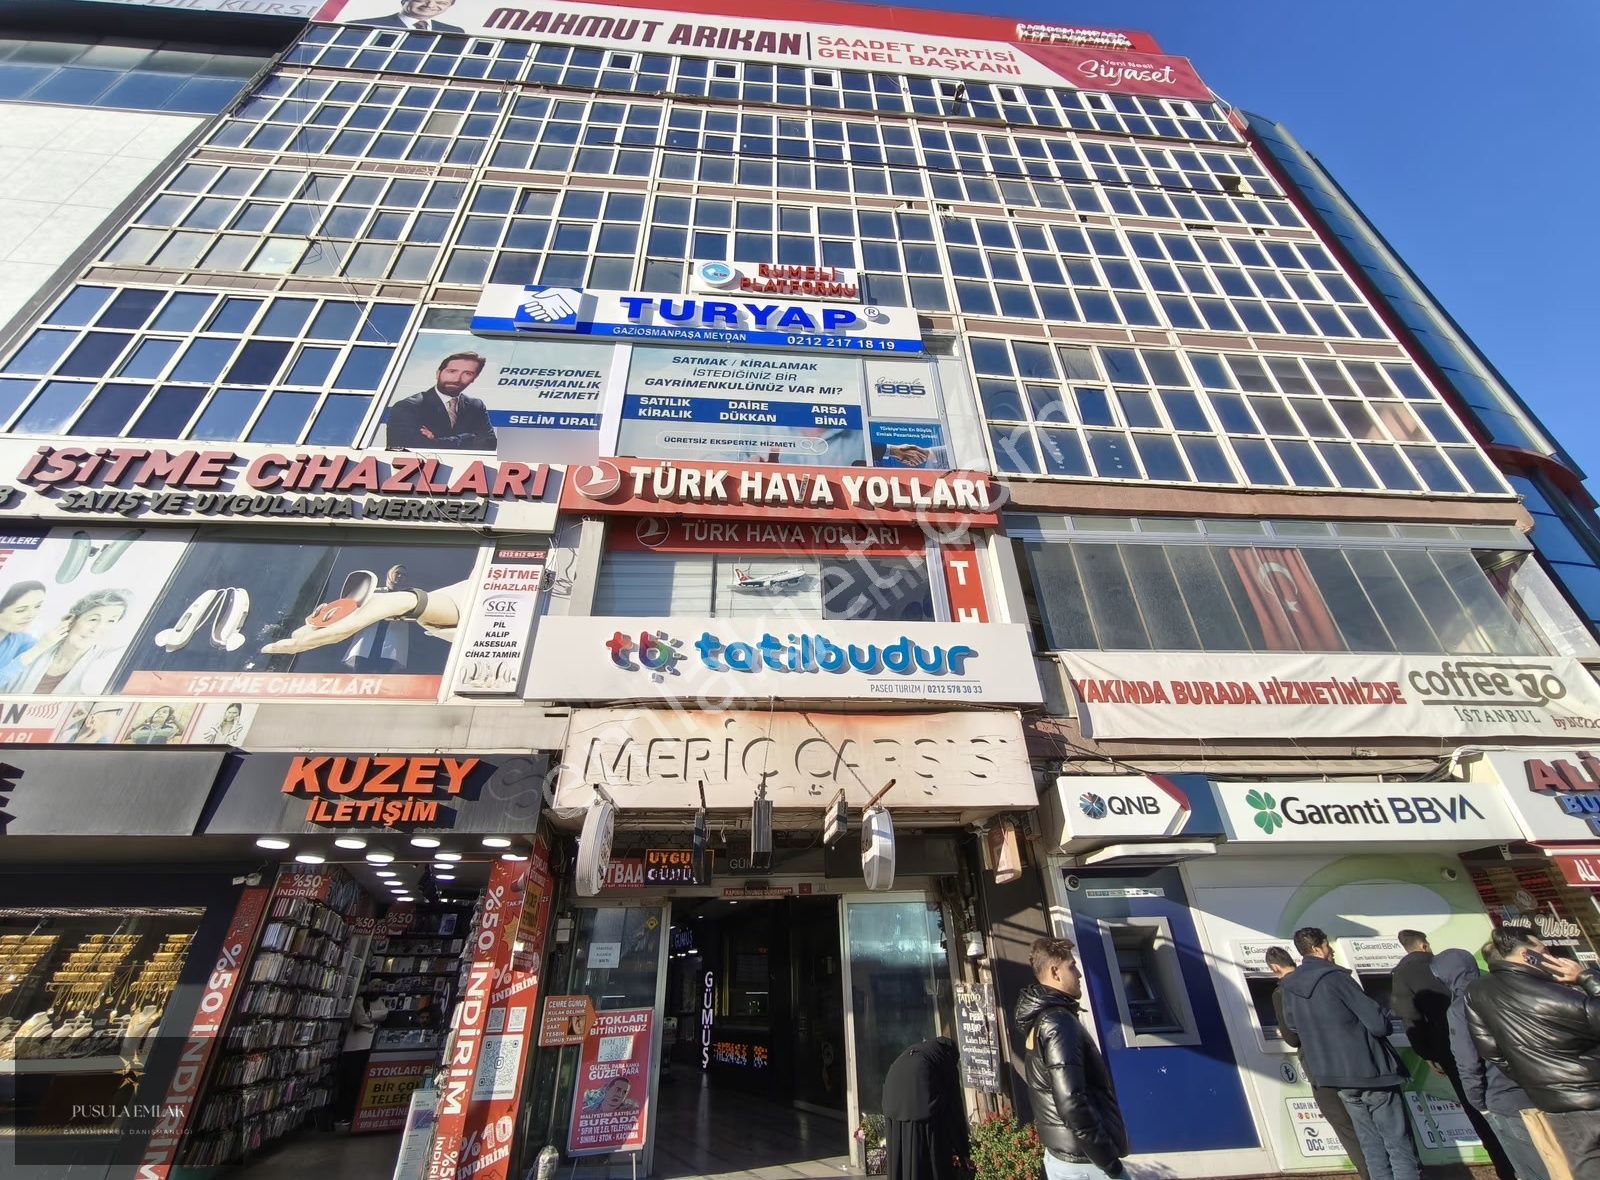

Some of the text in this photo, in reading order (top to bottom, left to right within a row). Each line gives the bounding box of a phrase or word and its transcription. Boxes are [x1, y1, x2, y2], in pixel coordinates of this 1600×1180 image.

[483, 6, 802, 56] MAHMUT ARIKAN
[816, 35, 1017, 64] SAADET PARTİSİ
[818, 47, 1022, 76] GENEL BAŞKANI
[1077, 60, 1176, 87] Siyaset
[740, 277, 856, 298] PLATFORMU
[620, 297, 857, 332] TURYAP
[612, 326, 747, 342] GAZİOSMANPAŞA MEYDAN
[787, 335, 896, 350] 0212 217 18 19
[672, 356, 728, 367] SATMAK
[740, 358, 818, 371] KİRALAMAK
[499, 367, 602, 379] PROFESYONEL
[692, 368, 798, 382] İSTEDİĞİNİZ BİR
[497, 378, 602, 390] DANIŞMANLIK
[644, 377, 843, 395] GAYRİMENKULÜNÜZ VAR MI?
[875, 384, 926, 395] 1985
[538, 389, 600, 401] HİZMETİ
[639, 396, 692, 408] SATILIK
[638, 406, 693, 419] KİRALIK
[728, 400, 769, 411] DAİRE
[811, 405, 847, 415] ARSA
[509, 414, 598, 427] SELİM URAL
[719, 411, 777, 423] DÜKKAN
[814, 415, 848, 426] BİNA
[664, 435, 796, 448] ÜCRETSİZ EKSPERTİZ HİZMETİ
[16, 445, 550, 498] İŞİTME CİHAZLARI
[629, 461, 989, 510] TÜRK HAVA YOLLARI
[55, 490, 491, 520] SATIŞ VE UYGULAMA MERKEZİ
[681, 519, 900, 545] TÜRK HAVA YOLLARI
[487, 567, 540, 581] İŞİTME
[483, 581, 539, 592] CİHAZLARI
[486, 600, 518, 612] SGK
[473, 640, 518, 648] AKSESUAR
[694, 631, 978, 676] tatilbudur
[187, 677, 383, 696] İŞİTME CİHAZLARI
[870, 684, 894, 693] PASEO
[927, 684, 946, 694] 0212
[947, 685, 961, 694] 578
[1072, 675, 1407, 706] YAKINDA BURADA HİZMETİNİZDE
[1408, 661, 1567, 706] coffee go
[1455, 704, 1541, 725] İSTANBUL
[280, 755, 480, 794] KUZEY
[305, 795, 438, 827] İLETİŞİM
[1107, 795, 1161, 817] QNB
[1281, 793, 1487, 825] Garanti BBVA
[648, 851, 693, 865] UYGU
[291, 873, 322, 888] %50
[478, 884, 504, 954] %50
[1534, 914, 1581, 938] Usta
[491, 975, 538, 1004] İNDİRİM
[593, 1014, 648, 1027] STOKLARI
[701, 970, 714, 1069] GÜMÜŞ
[590, 1024, 647, 1036] BİTİRİYORUZ
[443, 960, 496, 1116] İNDİRİM
[136, 943, 243, 1180] %50 İNDİRİM
[368, 1065, 420, 1077] STOKLARI
[621, 1067, 640, 1077] PARA
[372, 1081, 394, 1093] BİR
[579, 1115, 639, 1127] BURADA
[1427, 1130, 1447, 1143] DC
[1305, 1138, 1325, 1151] DCC
[457, 1144, 510, 1180] İNDİRİM
